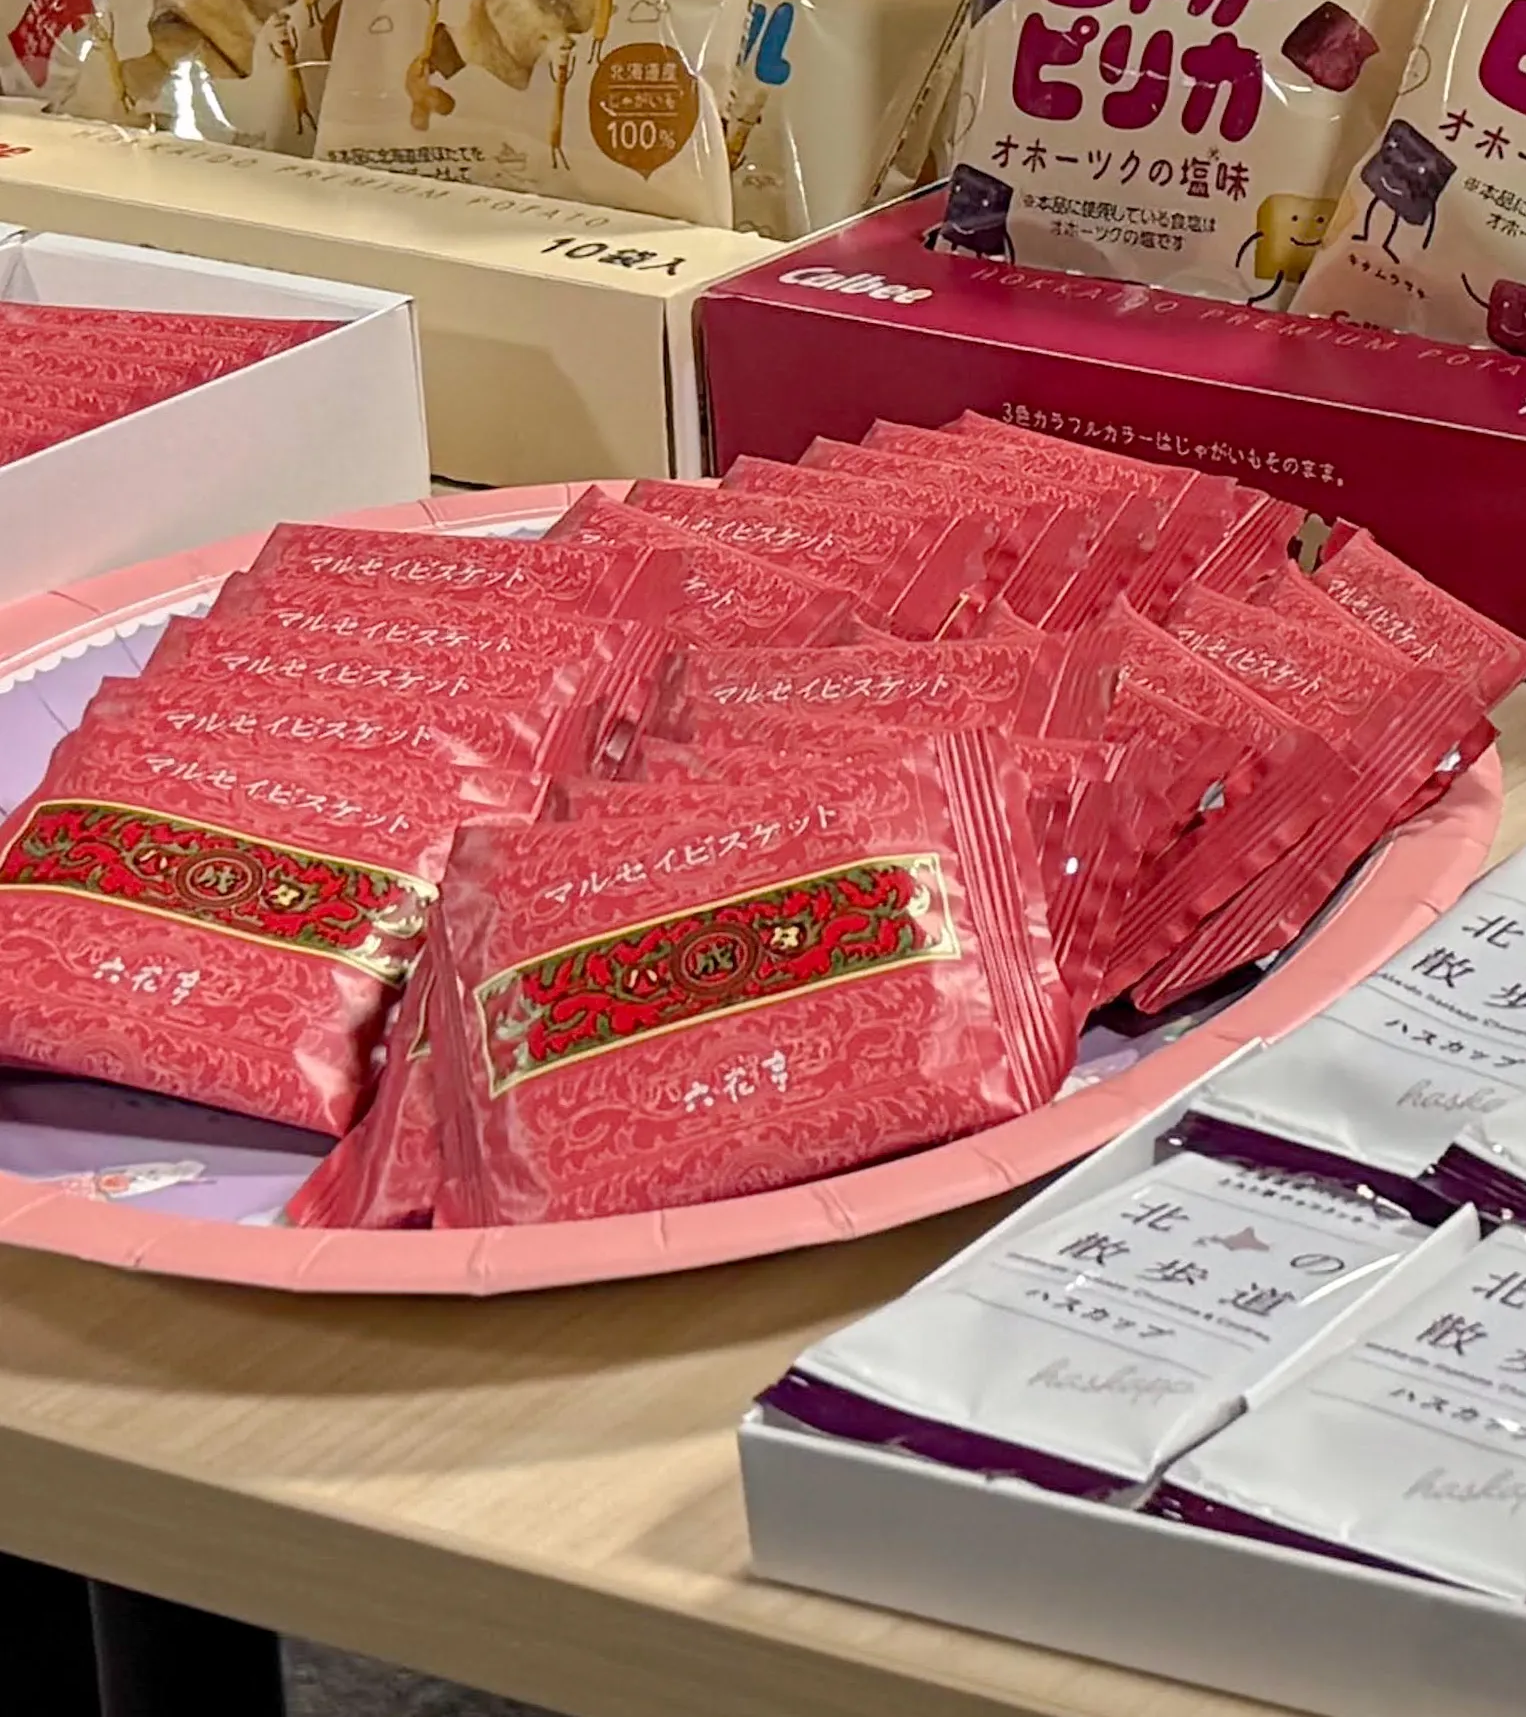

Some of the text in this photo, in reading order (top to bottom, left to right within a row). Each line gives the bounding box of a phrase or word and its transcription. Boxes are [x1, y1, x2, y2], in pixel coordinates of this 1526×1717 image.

[1013, 12, 1264, 142] ピリカ
[605, 119, 677, 152] 100%
[991, 134, 1250, 202] オホーツクの塩味
[536, 236, 688, 278] 10袋入
[777, 265, 934, 305] Calbee
[1000, 400, 1346, 488] 3色カラフルカラーはじゃがいもそのまま。
[310, 553, 529, 589] マルセイビスケット
[218, 653, 471, 697] マルセイビスケット
[712, 672, 949, 705] マルセイビスケット
[165, 712, 434, 749] マルセイビスケット
[144, 753, 412, 836] マルセイビスケット
[542, 803, 840, 906] マルセイビスケット
[93, 957, 201, 1006] 六花亭
[1384, 1018, 1526, 1068] ハスカップ
[683, 1049, 789, 1113] 六花亭
[1059, 1230, 1300, 1318] 散歩道
[1022, 1285, 1177, 1340] ハスカップ
